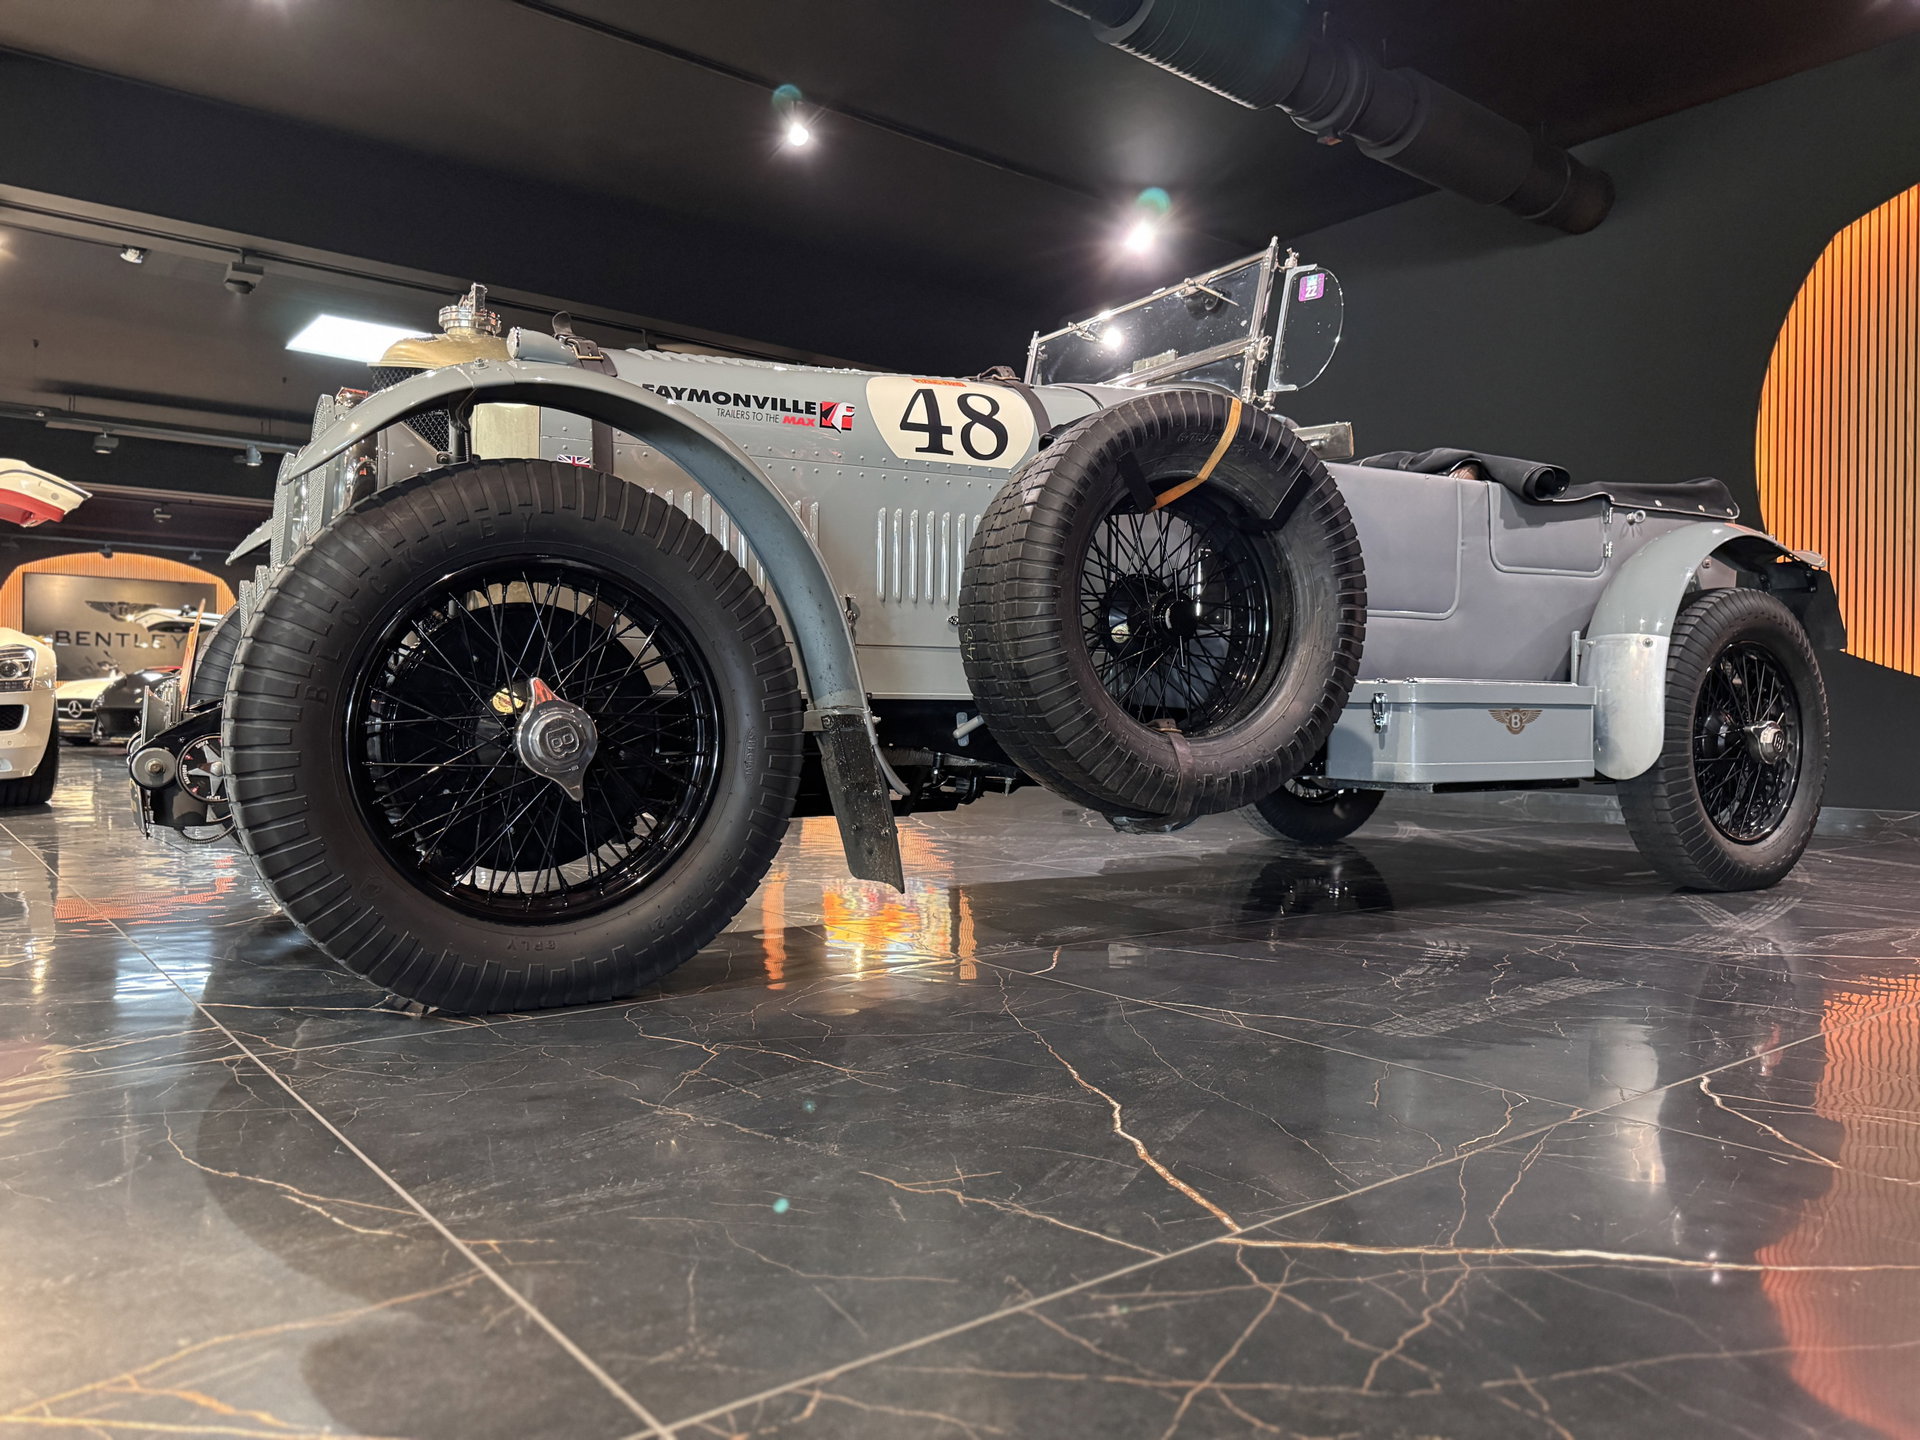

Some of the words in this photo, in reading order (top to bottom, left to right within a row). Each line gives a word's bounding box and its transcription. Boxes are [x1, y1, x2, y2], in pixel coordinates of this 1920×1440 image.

[717, 407, 750, 421] TRAILERS
[752, 412, 763, 422] TO
[765, 413, 780, 424] THE
[782, 415, 816, 428] MAX
[899, 388, 1009, 461] 48
[55, 630, 186, 650] BENTLEY
